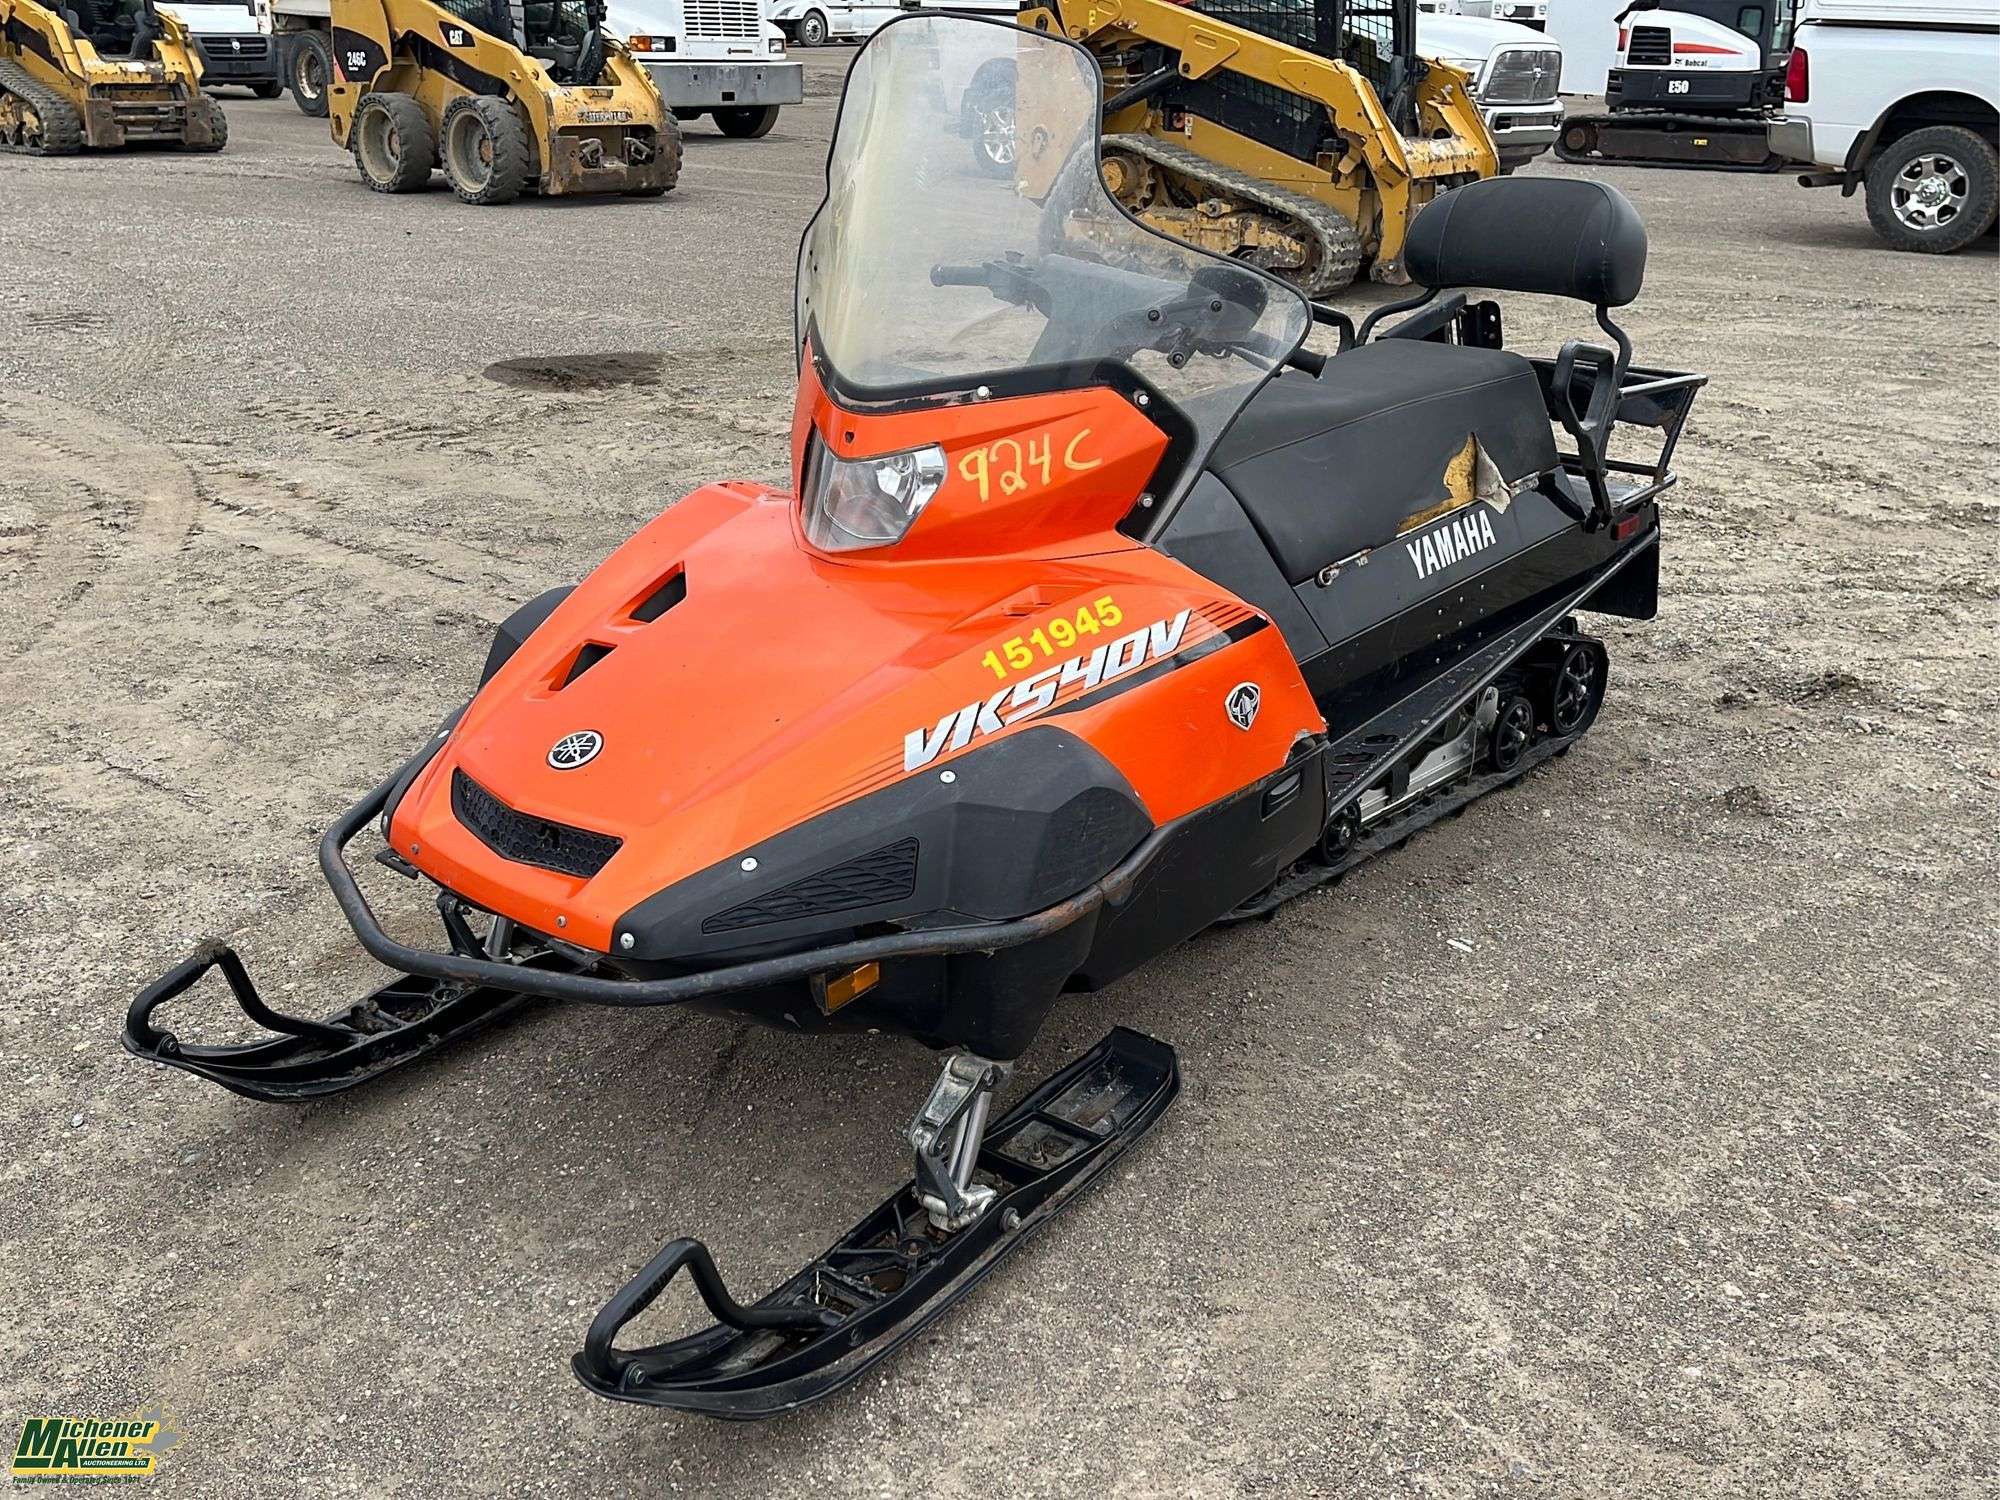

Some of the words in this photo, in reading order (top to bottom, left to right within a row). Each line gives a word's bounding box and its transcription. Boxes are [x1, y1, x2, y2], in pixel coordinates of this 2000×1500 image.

[449, 29, 464, 45] CAT
[346, 51, 367, 67] 246C
[1685, 59, 1708, 67] Bobcat
[1668, 80, 1689, 94] E50
[1406, 509, 1497, 580] YAMAHA
[981, 595, 1124, 680] 151945
[904, 608, 1193, 772] VK540V
